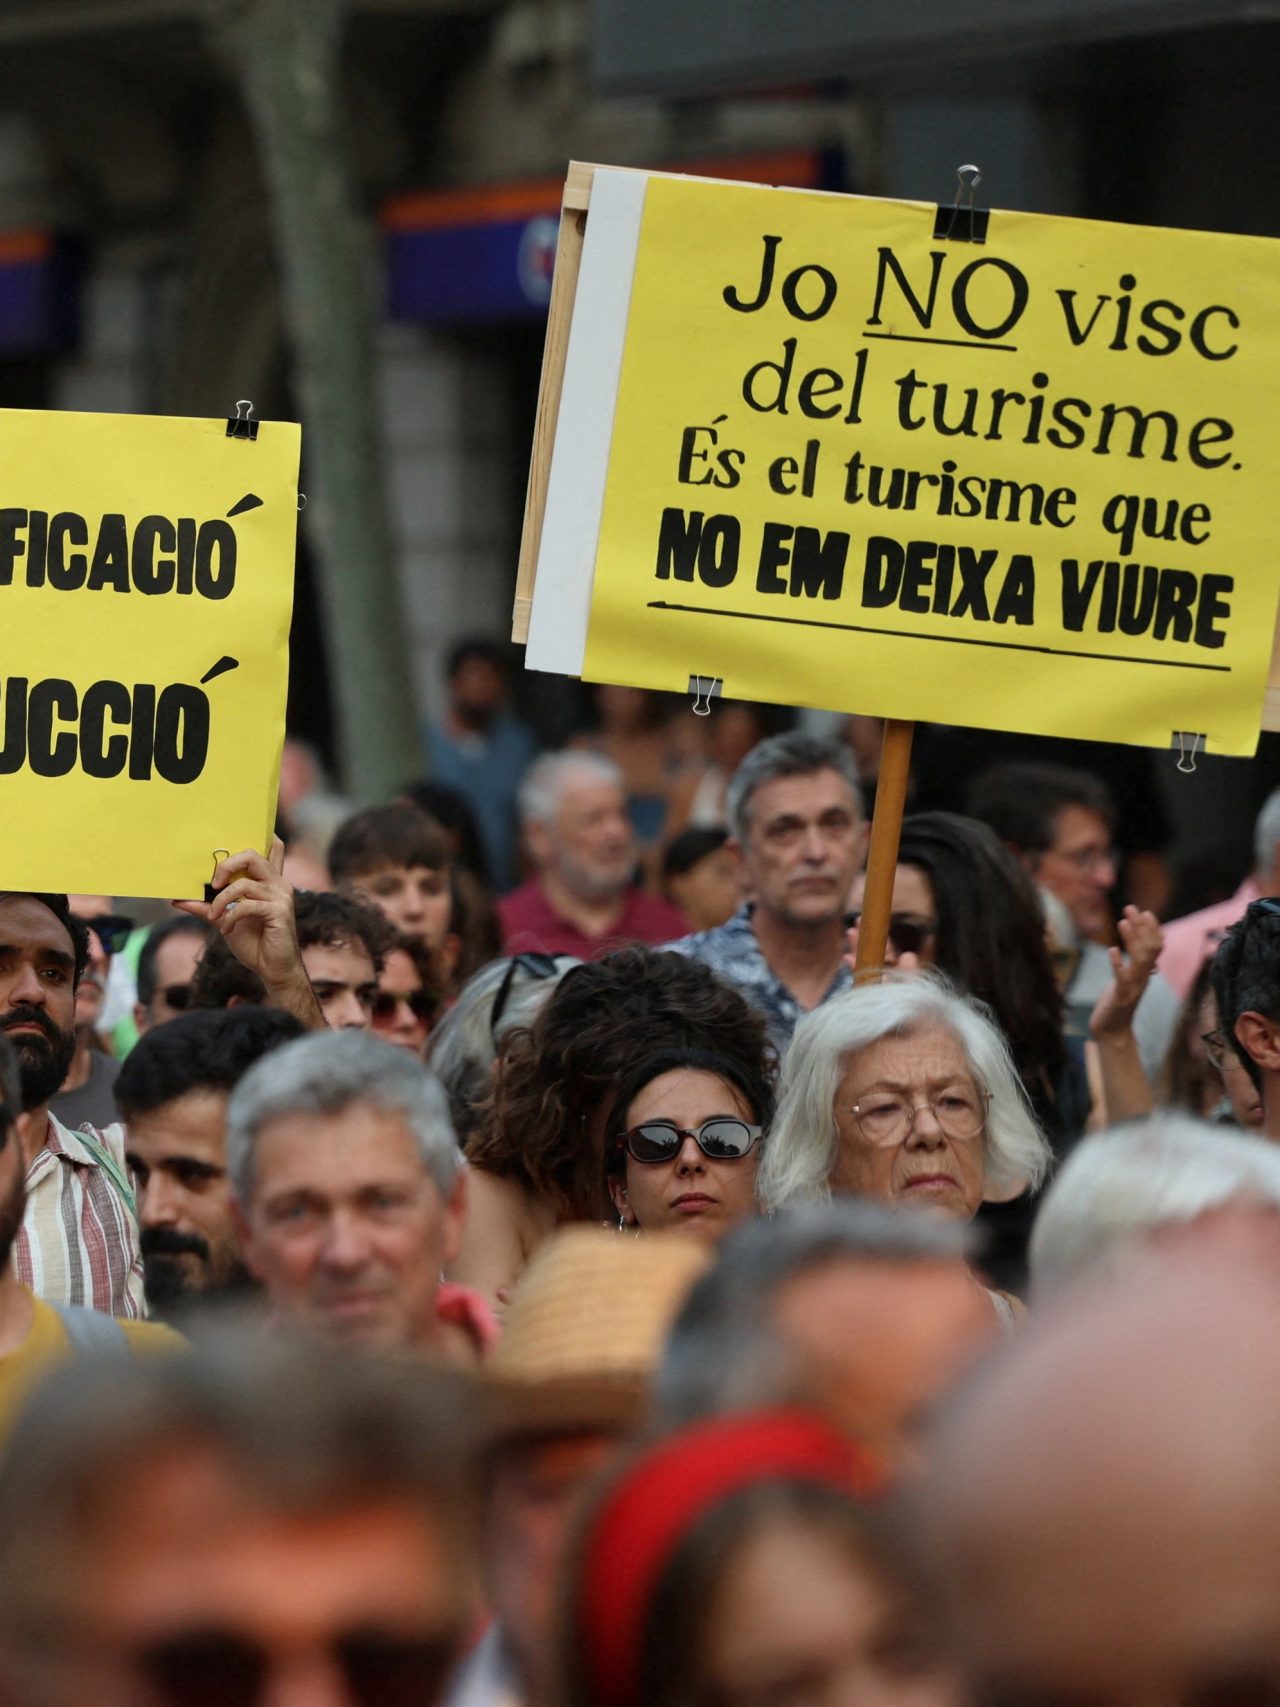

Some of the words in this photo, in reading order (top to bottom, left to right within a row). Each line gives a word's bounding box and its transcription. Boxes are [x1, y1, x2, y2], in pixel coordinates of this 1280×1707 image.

[722, 234, 839, 322] Jo
[865, 246, 1029, 340] NO
[1055, 273, 1241, 361] visc
[742, 337, 869, 425] del
[894, 369, 1244, 472] turisme.
[677, 414, 746, 489] És
[769, 438, 821, 498] el
[842, 451, 1078, 530] turisme
[1101, 494, 1213, 558] que
[654, 507, 741, 588] NO
[755, 522, 851, 601] EM
[860, 535, 1036, 626] DEIXA
[1060, 558, 1235, 649] VIURE
